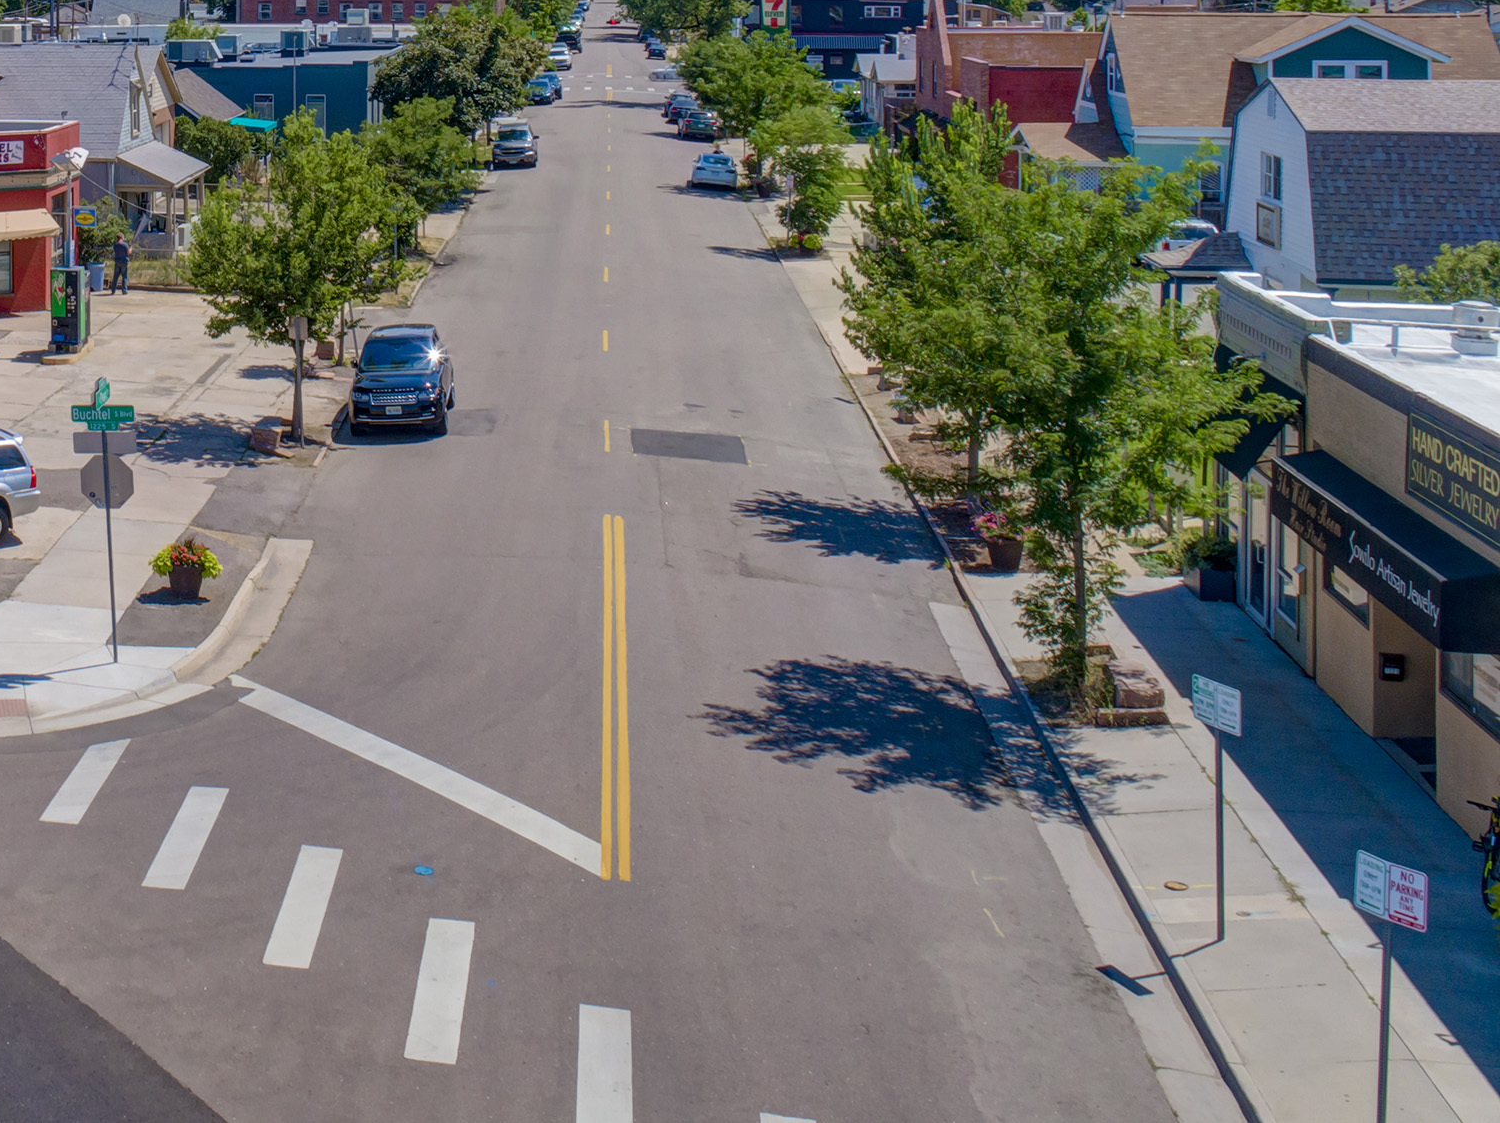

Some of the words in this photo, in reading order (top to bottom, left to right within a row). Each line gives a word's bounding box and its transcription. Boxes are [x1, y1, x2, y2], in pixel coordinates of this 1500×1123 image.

[72, 408, 111, 420] Buchtel
[1412, 426, 1444, 465] HAND
[1445, 444, 1500, 498] CRAFTED
[1410, 459, 1445, 498] SILVER
[1448, 481, 1500, 530] JEWELRY
[1348, 530, 1376, 572] Sowilo
[1376, 558, 1407, 597] Artisan
[1407, 580, 1441, 628] Jewelry
[1390, 879, 1424, 901] PARKING
[1400, 870, 1415, 885] NO
